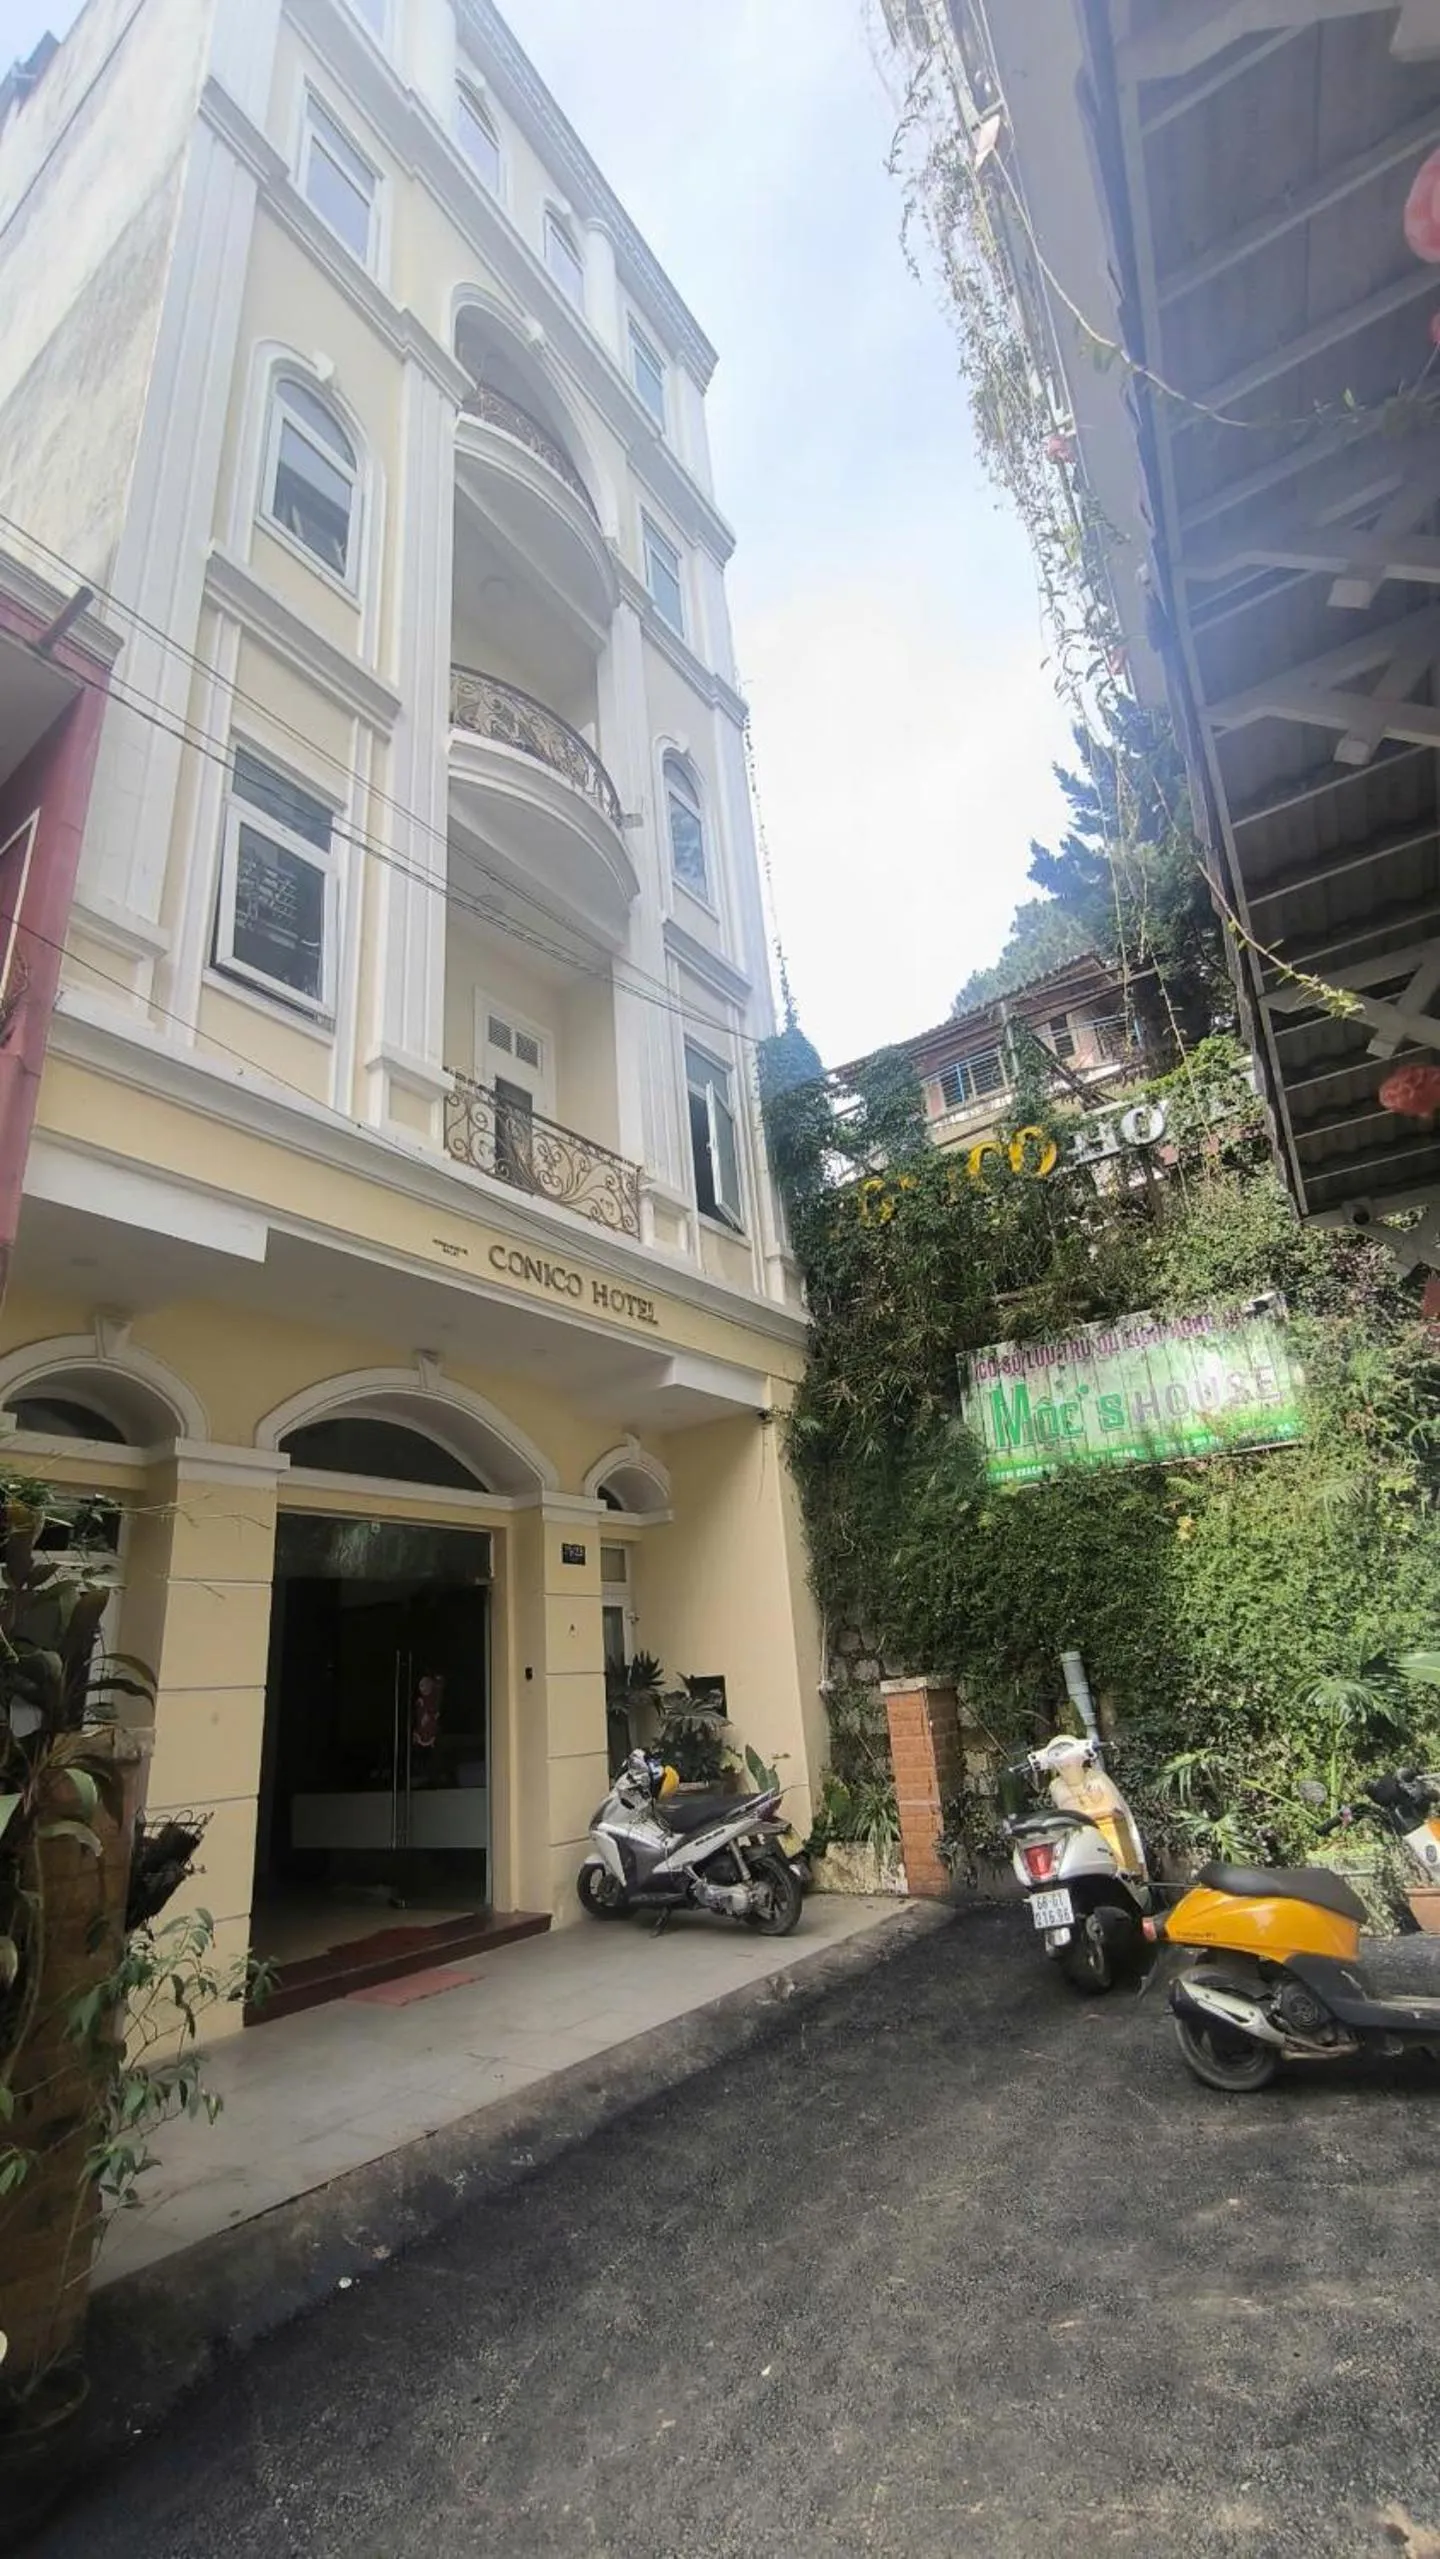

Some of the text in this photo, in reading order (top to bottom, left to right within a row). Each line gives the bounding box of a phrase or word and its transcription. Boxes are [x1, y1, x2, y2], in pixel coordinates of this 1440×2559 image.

[488, 1244, 658, 1325] CONICO HOTEL
[1132, 1364, 1282, 1424] HOUSE
